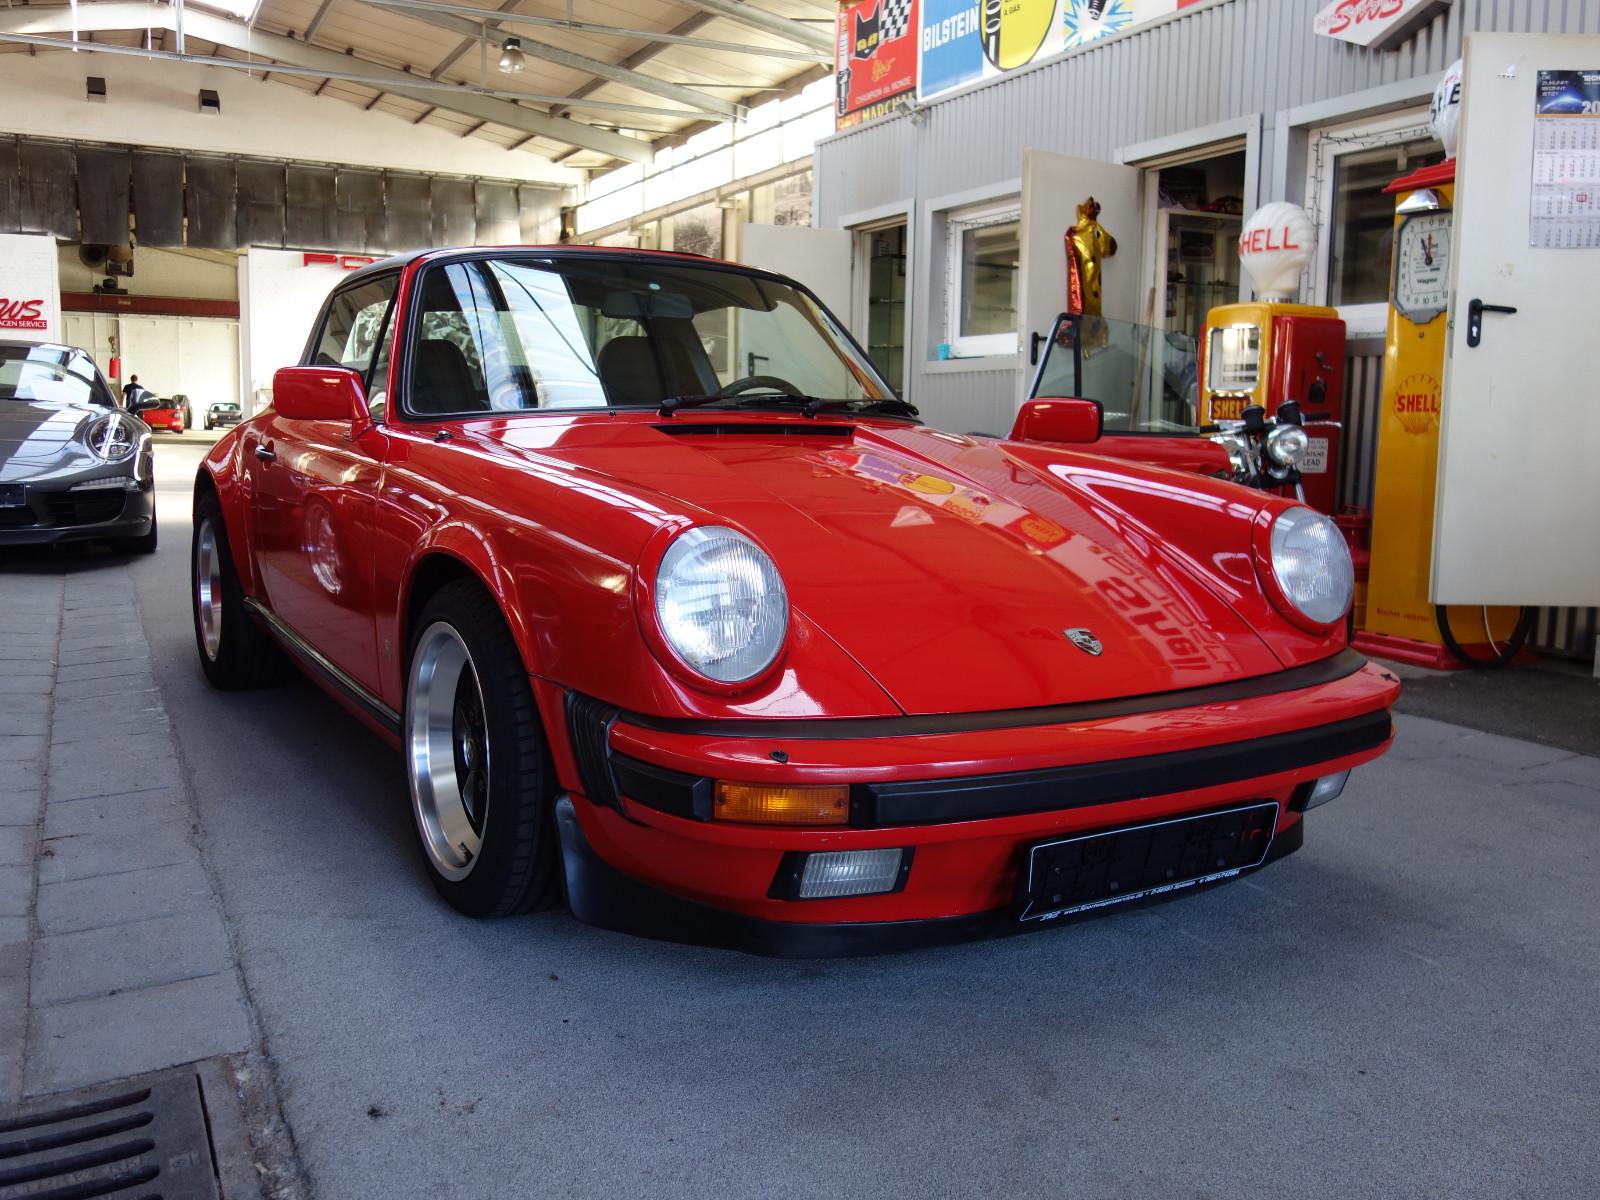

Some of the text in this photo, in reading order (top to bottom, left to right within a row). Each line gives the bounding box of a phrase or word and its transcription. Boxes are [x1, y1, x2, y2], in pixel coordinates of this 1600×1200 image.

[923, 6, 979, 52] BILSTEIN
[303, 252, 384, 270] PO
[18, 320, 47, 328] SERVICE
[1396, 393, 1438, 413] SHELL
[1302, 458, 1321, 466] LEAD
